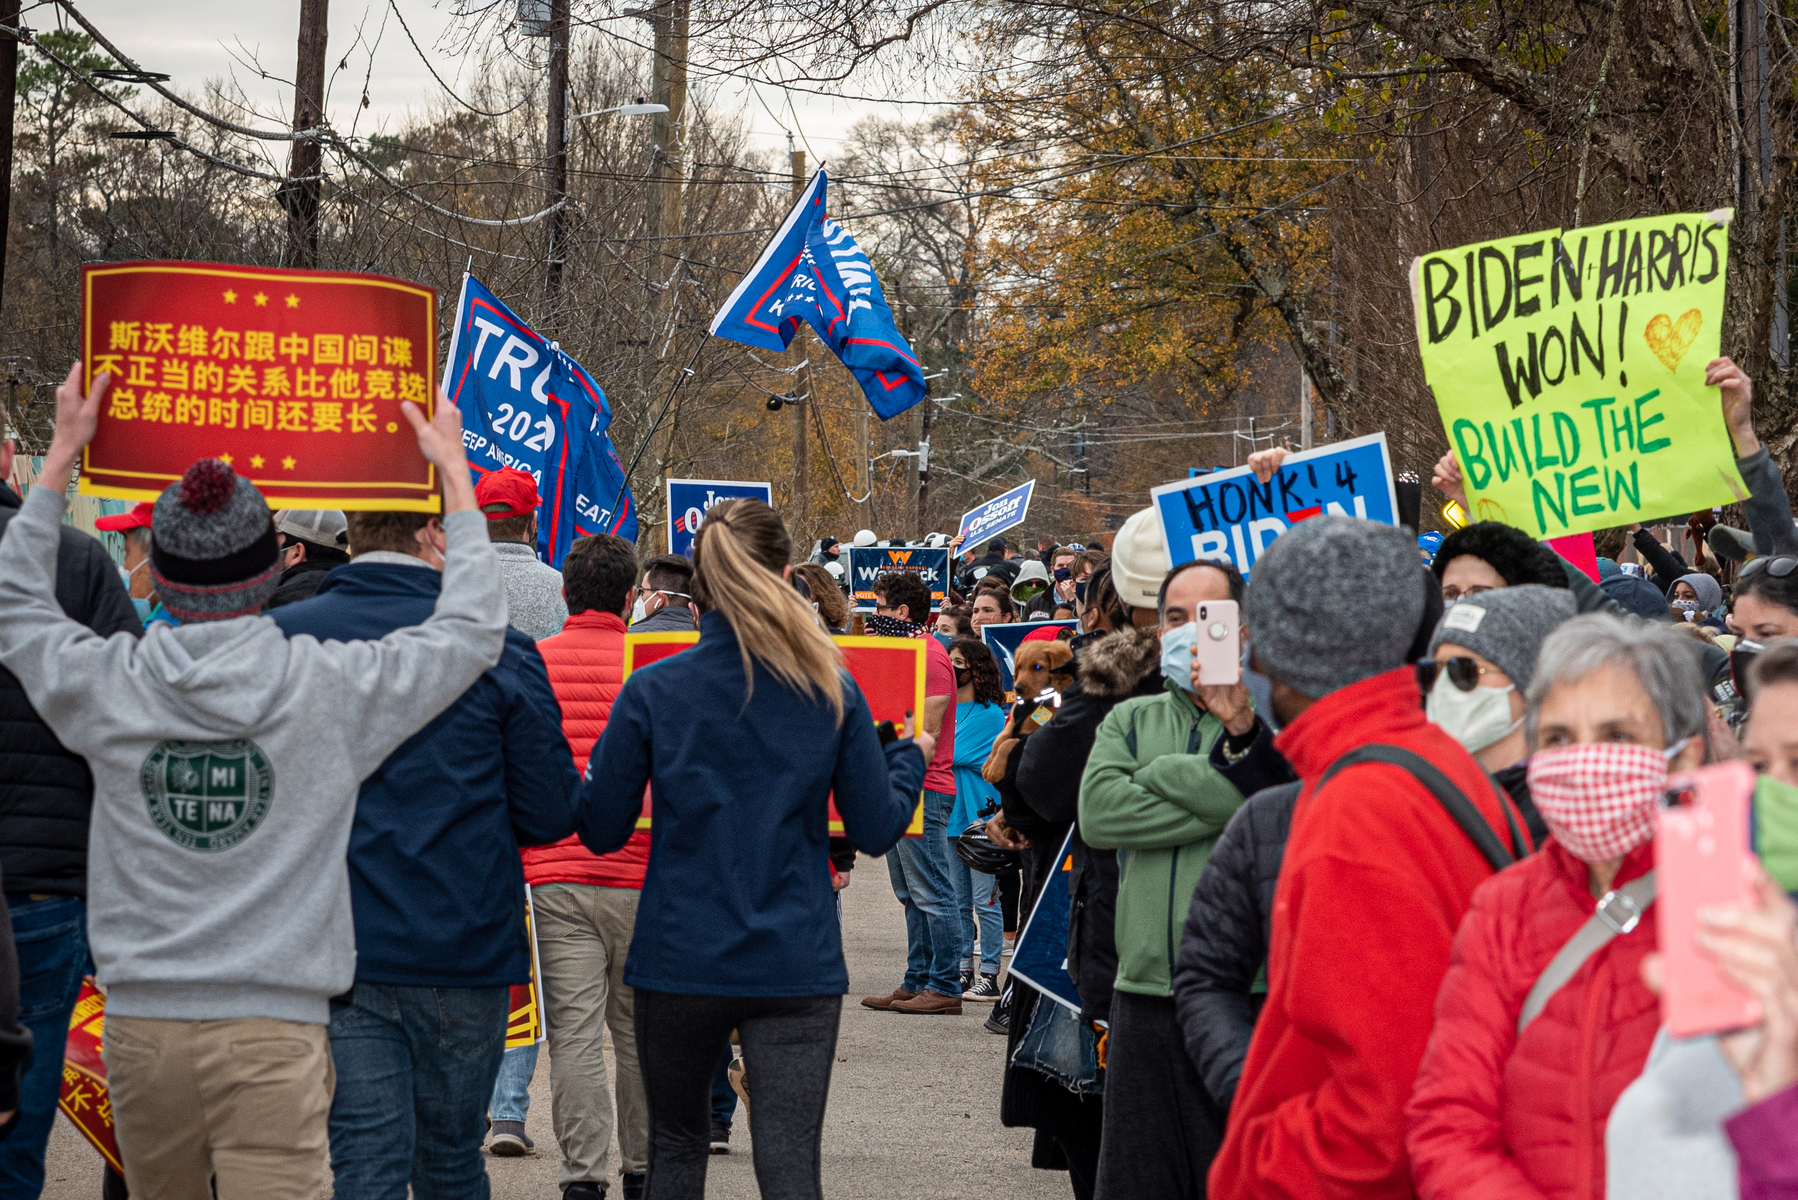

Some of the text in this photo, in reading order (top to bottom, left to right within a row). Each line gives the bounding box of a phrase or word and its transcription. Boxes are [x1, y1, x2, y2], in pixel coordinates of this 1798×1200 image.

[109, 320, 413, 368] 斯沃维尔跟中国间谍
[1494, 300, 1629, 409] WON!
[93, 353, 427, 405] 不正当的关系比他竞选
[108, 386, 399, 434] 总统的时间还要长。
[460, 427, 488, 451] EEP
[1453, 388, 1672, 490] BUILD THE
[1335, 460, 1358, 495] 4
[703, 490, 736, 511] Jo
[968, 495, 1023, 532] Ossoff
[983, 498, 1009, 516] Jon
[1532, 461, 1641, 535] NEW
[969, 526, 985, 538] U.S.
[985, 509, 1018, 530] SENATE
[858, 567, 939, 581] Wack
[211, 766, 237, 788] MI
[174, 799, 237, 822] TE NA
